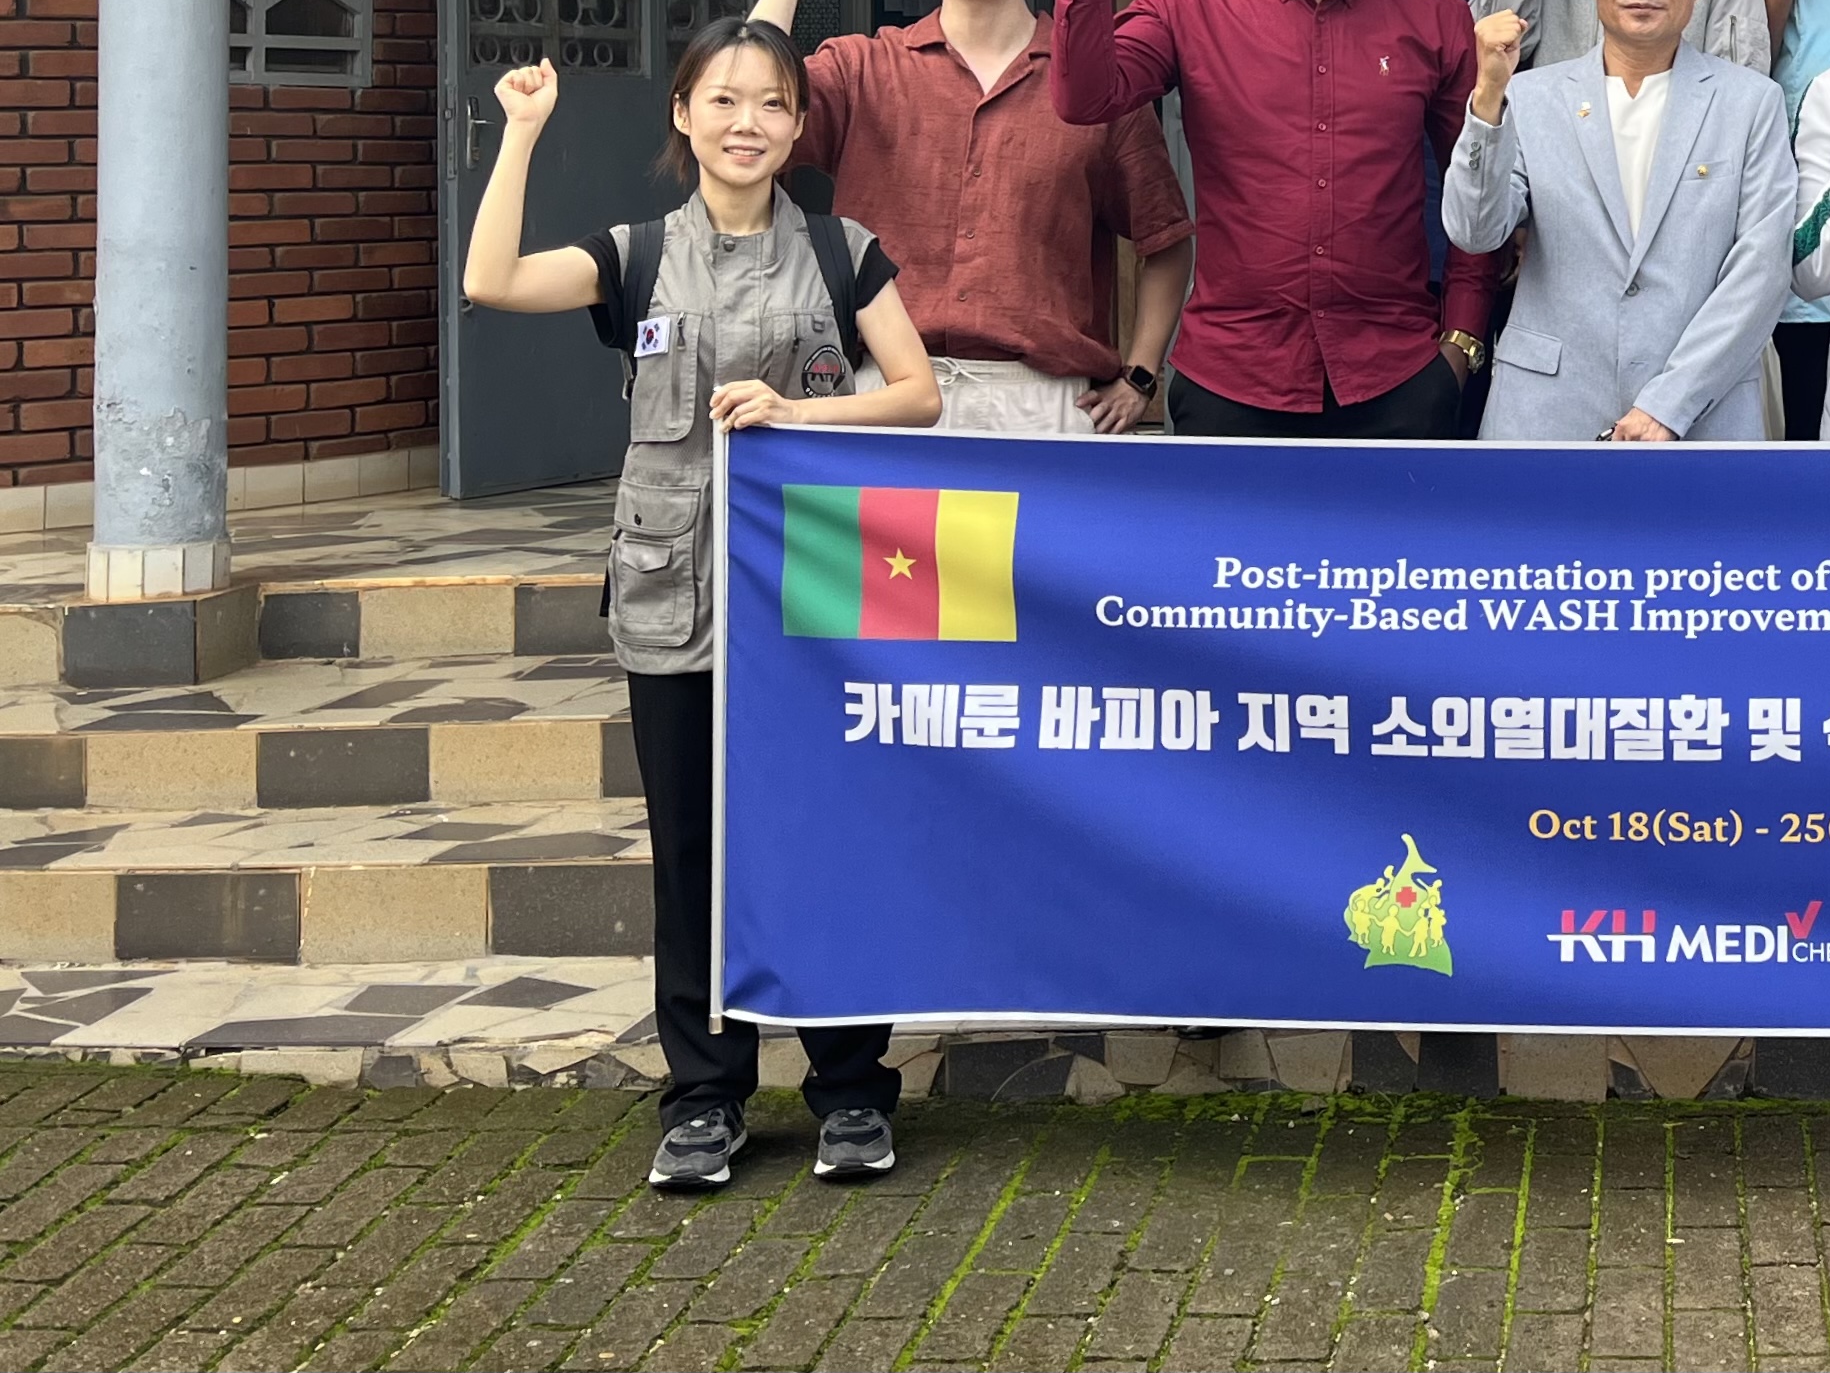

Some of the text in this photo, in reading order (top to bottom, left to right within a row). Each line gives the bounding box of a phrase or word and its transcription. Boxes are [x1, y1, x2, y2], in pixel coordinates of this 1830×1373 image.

[1212, 556, 1635, 598] Post-implementation
[1644, 560, 1782, 599] project
[1095, 595, 1469, 639] Community-Based
[1478, 598, 1620, 632] WASH
[844, 681, 1021, 749] 카메룬
[1038, 685, 1220, 751] 바피아
[1237, 692, 1350, 755] 지역
[1370, 693, 1730, 762] 소외열대질환
[1748, 697, 1802, 762] 및
[1528, 809, 1598, 840] Oct
[1608, 808, 1743, 847] 18(Sat)
[1546, 909, 1657, 963] KH
